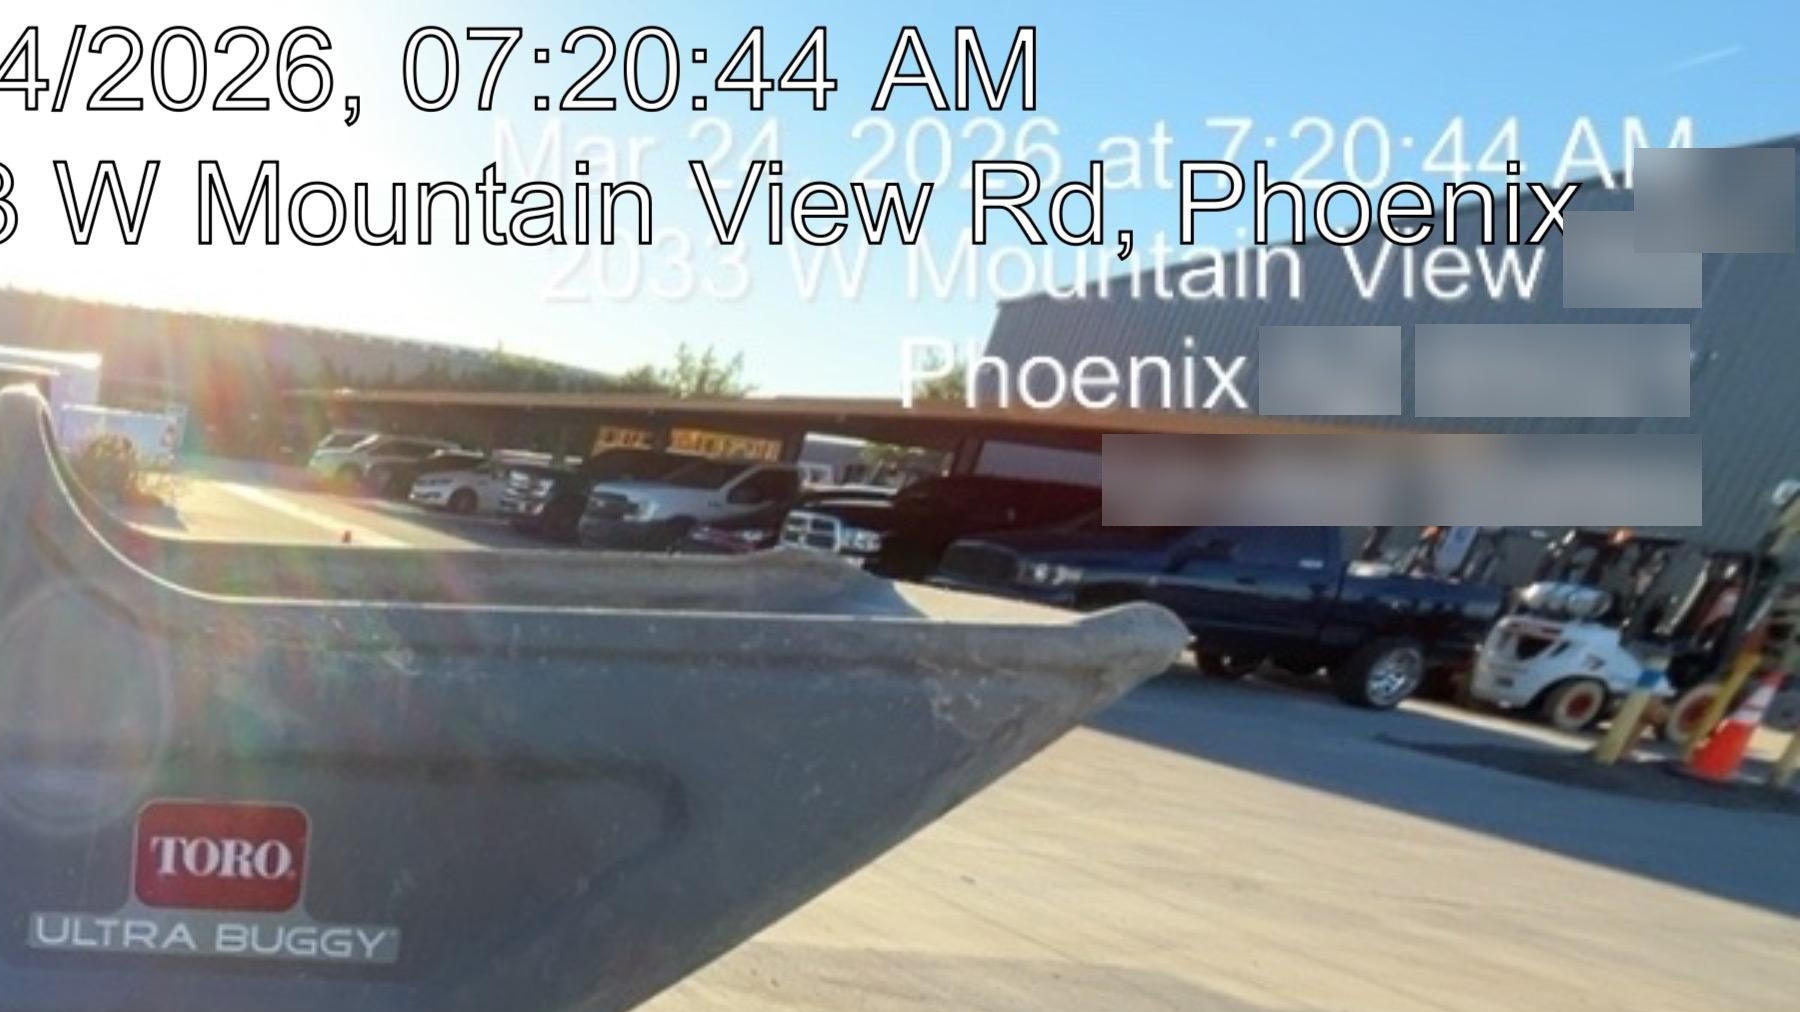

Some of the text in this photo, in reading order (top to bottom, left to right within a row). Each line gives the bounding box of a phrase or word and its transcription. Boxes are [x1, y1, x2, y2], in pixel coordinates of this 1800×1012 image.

[151, 836, 293, 879] TORO
[35, 915, 386, 959] ULTRA BUGGY
